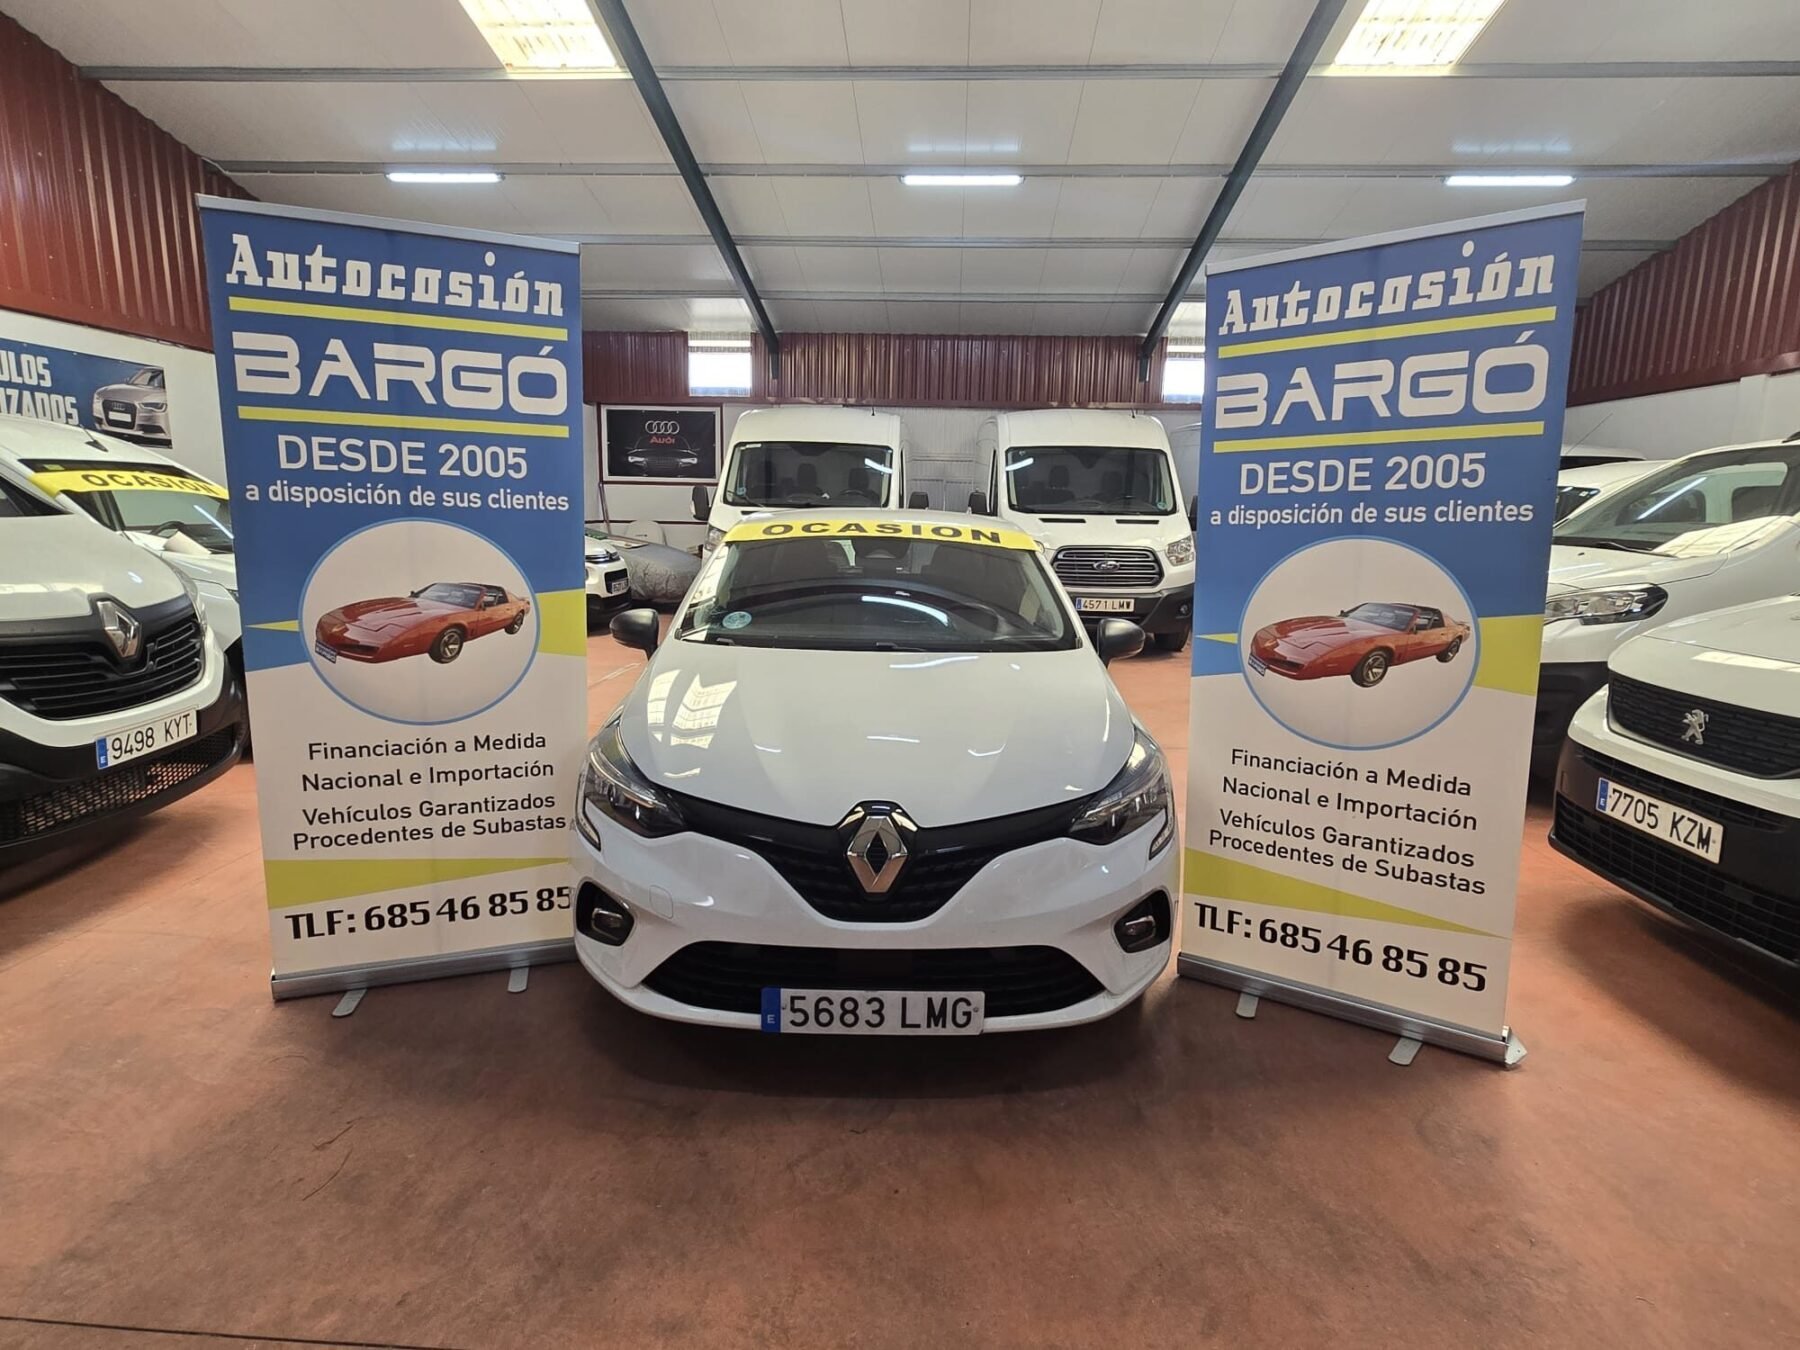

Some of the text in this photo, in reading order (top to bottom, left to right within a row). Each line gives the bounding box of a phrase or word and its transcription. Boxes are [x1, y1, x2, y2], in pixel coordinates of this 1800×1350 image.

[226, 234, 563, 316] Autocasión
[1218, 240, 1554, 335] Autocasión
[232, 331, 567, 416] BARGÓ
[1215, 330, 1549, 429] BARGÓ
[278, 434, 527, 478] DESDE 2005
[650, 436, 675, 444] Audi
[81, 474, 220, 495] OCASION
[245, 480, 569, 510] a disposición de sus clientes
[1240, 452, 1486, 495] DESDE 2005
[762, 522, 1001, 543] OCASION
[1210, 500, 1534, 528] a disposición de sus clientes
[1083, 600, 1108, 609] 4571
[112, 727, 155, 759] 9498
[164, 713, 190, 742] KYT
[308, 733, 546, 760] Financiación a Medida
[302, 761, 554, 791] Nacional e Importación
[1231, 749, 1472, 795] Financiación a Medida
[302, 793, 555, 825] Vehículos Garantizados
[1223, 777, 1477, 830] Nacional e Importación
[1610, 788, 1659, 829] 7705
[1669, 812, 1712, 853] KZM
[293, 815, 566, 850] Procedentes de Subastas
[1219, 809, 1475, 867] Vehículos Garantizados
[1209, 830, 1485, 895] Procedentes de Subastas
[284, 886, 571, 939] TLF: 685 46 85 85
[1194, 902, 1488, 992] TLF: 685 46 85 85
[767, 995, 972, 1029] E 5683 LMG
